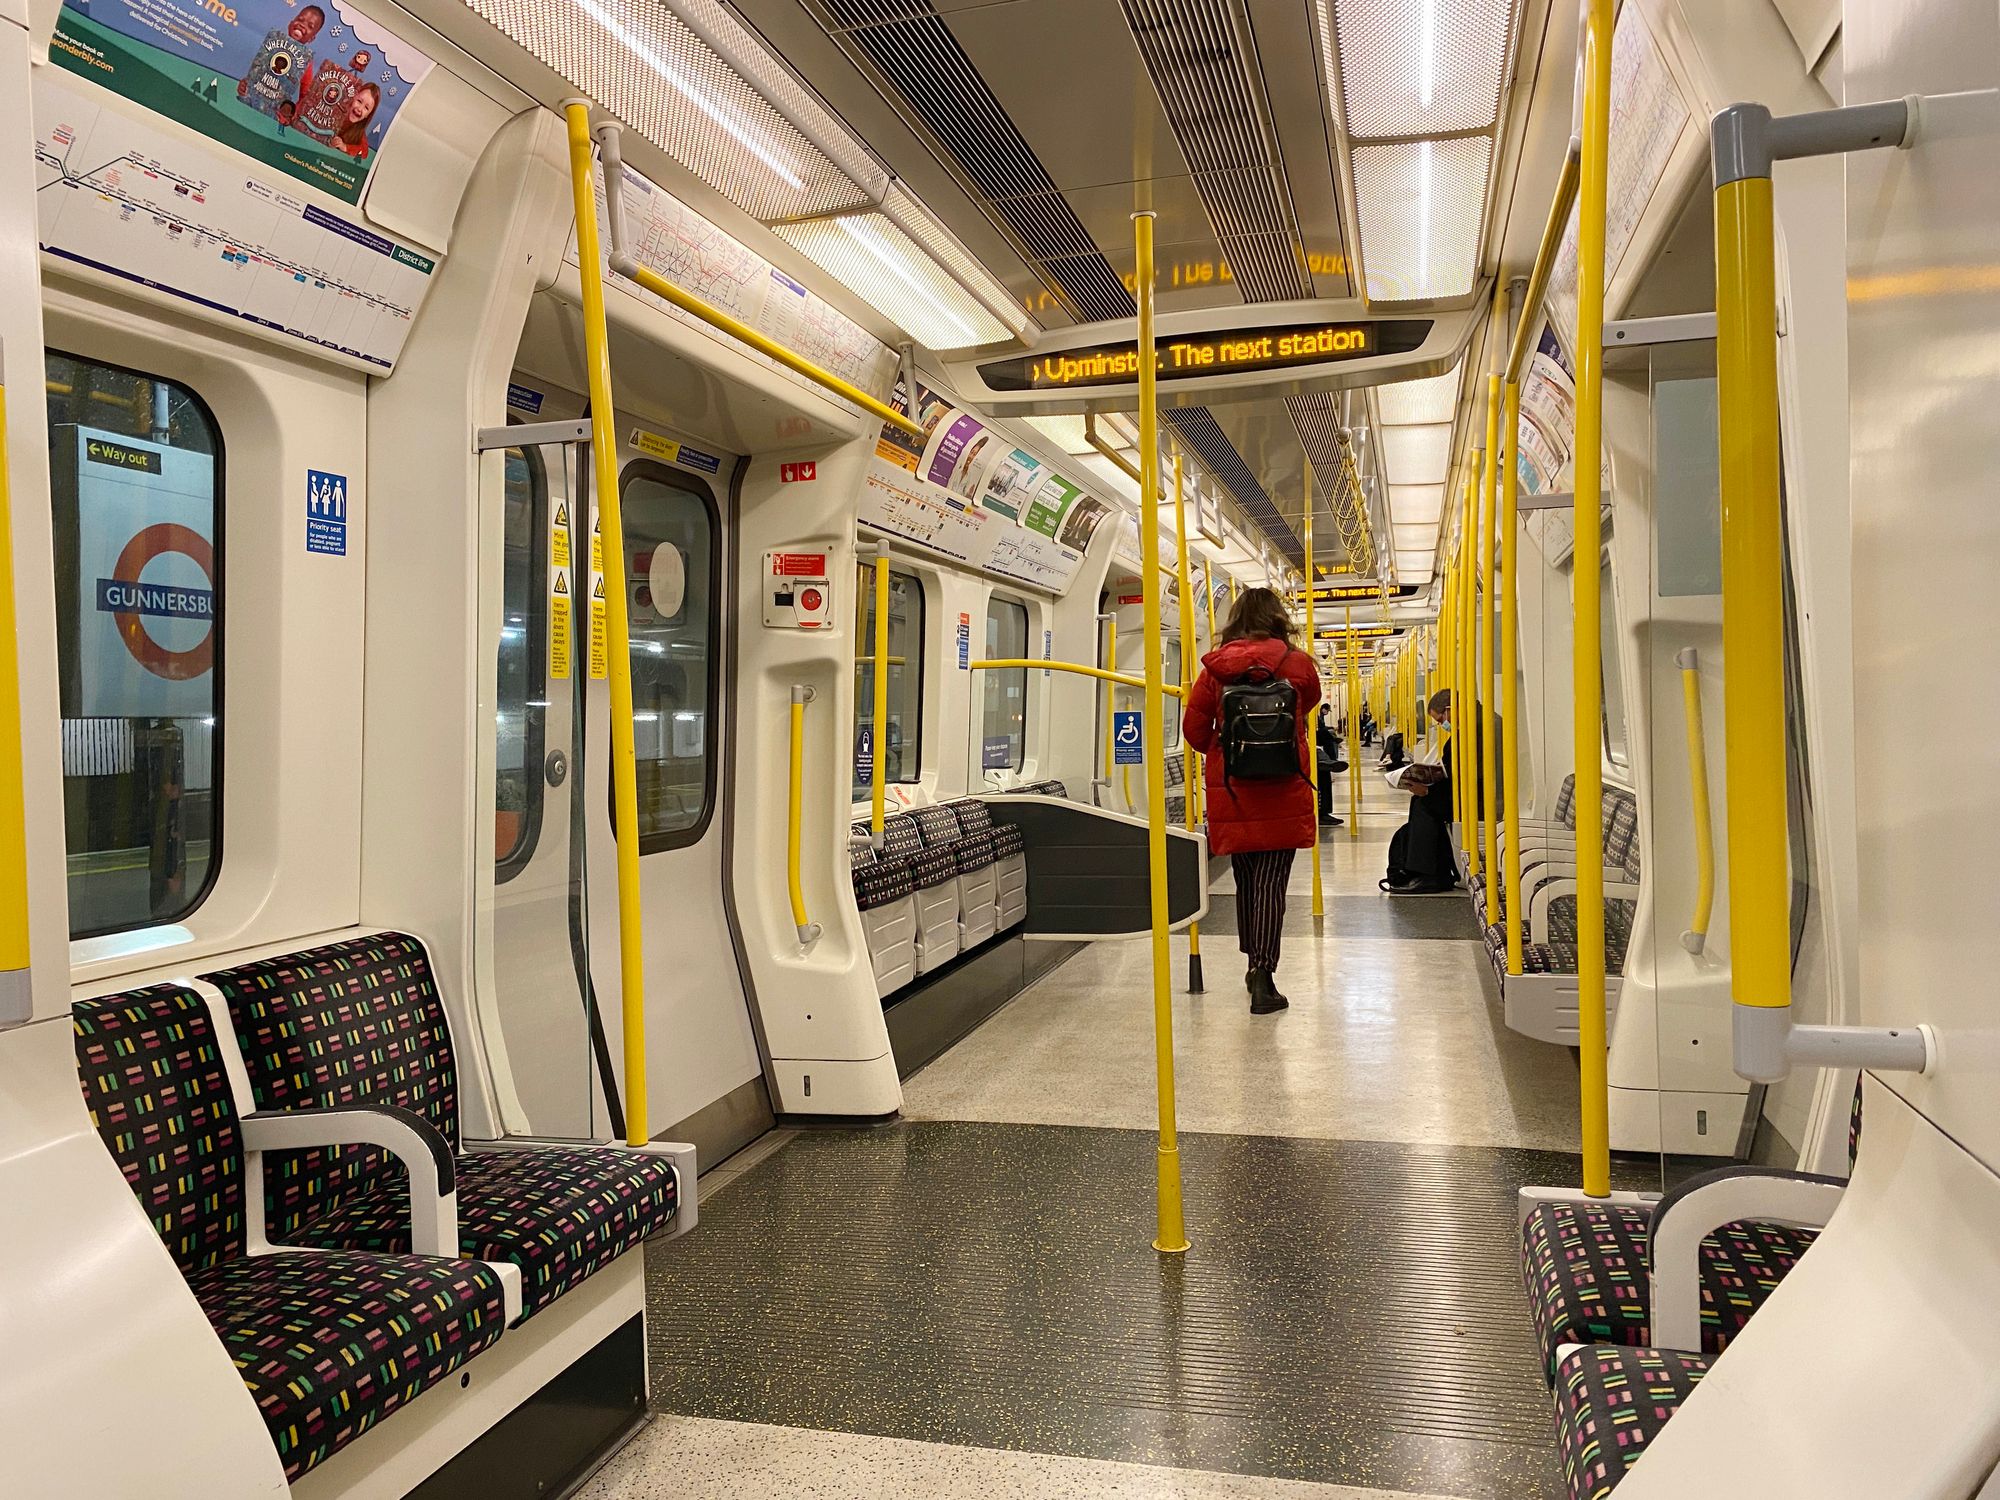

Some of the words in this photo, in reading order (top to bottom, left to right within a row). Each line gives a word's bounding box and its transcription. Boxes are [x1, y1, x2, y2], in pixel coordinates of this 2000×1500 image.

[204, 0, 238, 26] me.
[264, 39, 288, 51] WHERE
[287, 44, 301, 57] ARE
[50, 38, 114, 72] wonderbly.com
[295, 54, 305, 69] YOU
[261, 72, 280, 90] NOAH
[318, 70, 341, 82] WHERE
[339, 73, 352, 87] ARE
[347, 84, 355, 98] YOU
[315, 101, 334, 116] DAISY
[306, 107, 336, 128] BROWNE?
[398, 249, 419, 265] District
[417, 258, 429, 270] line
[1045, 352, 1164, 383] Upminst.
[1170, 344, 1214, 366] The
[1220, 337, 1272, 361] next
[1278, 329, 1365, 356] station
[102, 445, 127, 464] Way
[128, 453, 147, 466] out
[310, 521, 330, 533] Priority
[1290, 591, 1330, 600] Umster.
[1348, 588, 1366, 596] next
[1367, 586, 1396, 596] staon
